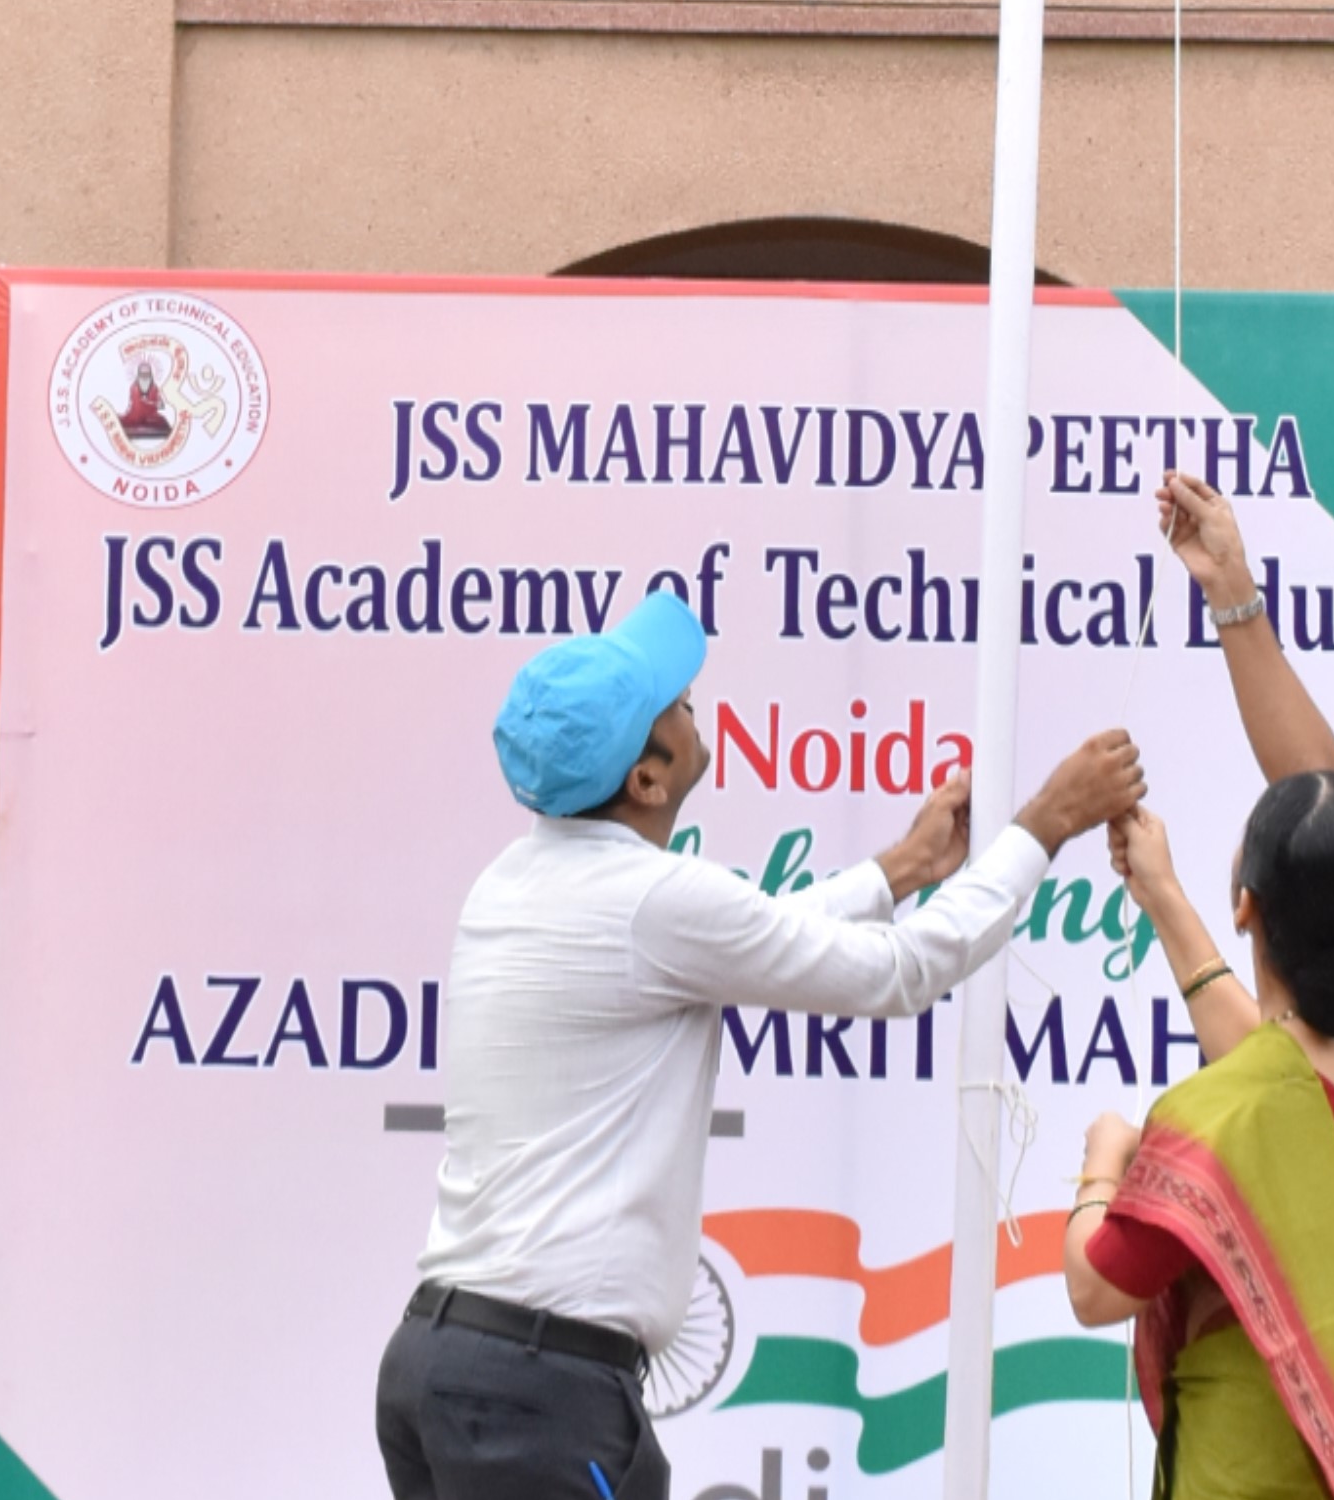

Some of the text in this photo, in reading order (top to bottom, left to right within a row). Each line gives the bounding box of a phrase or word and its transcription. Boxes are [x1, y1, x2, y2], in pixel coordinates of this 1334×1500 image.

[62, 311, 116, 380] ACADEMY
[119, 301, 141, 318] OF
[147, 298, 231, 340] TECHNICAL
[230, 339, 263, 434] EDUCATION
[112, 476, 201, 503] NOIDA
[389, 400, 504, 500] JSS
[100, 536, 223, 650] JSS
[714, 700, 974, 793] Noida
[130, 975, 439, 1070] AZADI
[717, 992, 953, 1080] MRIT
